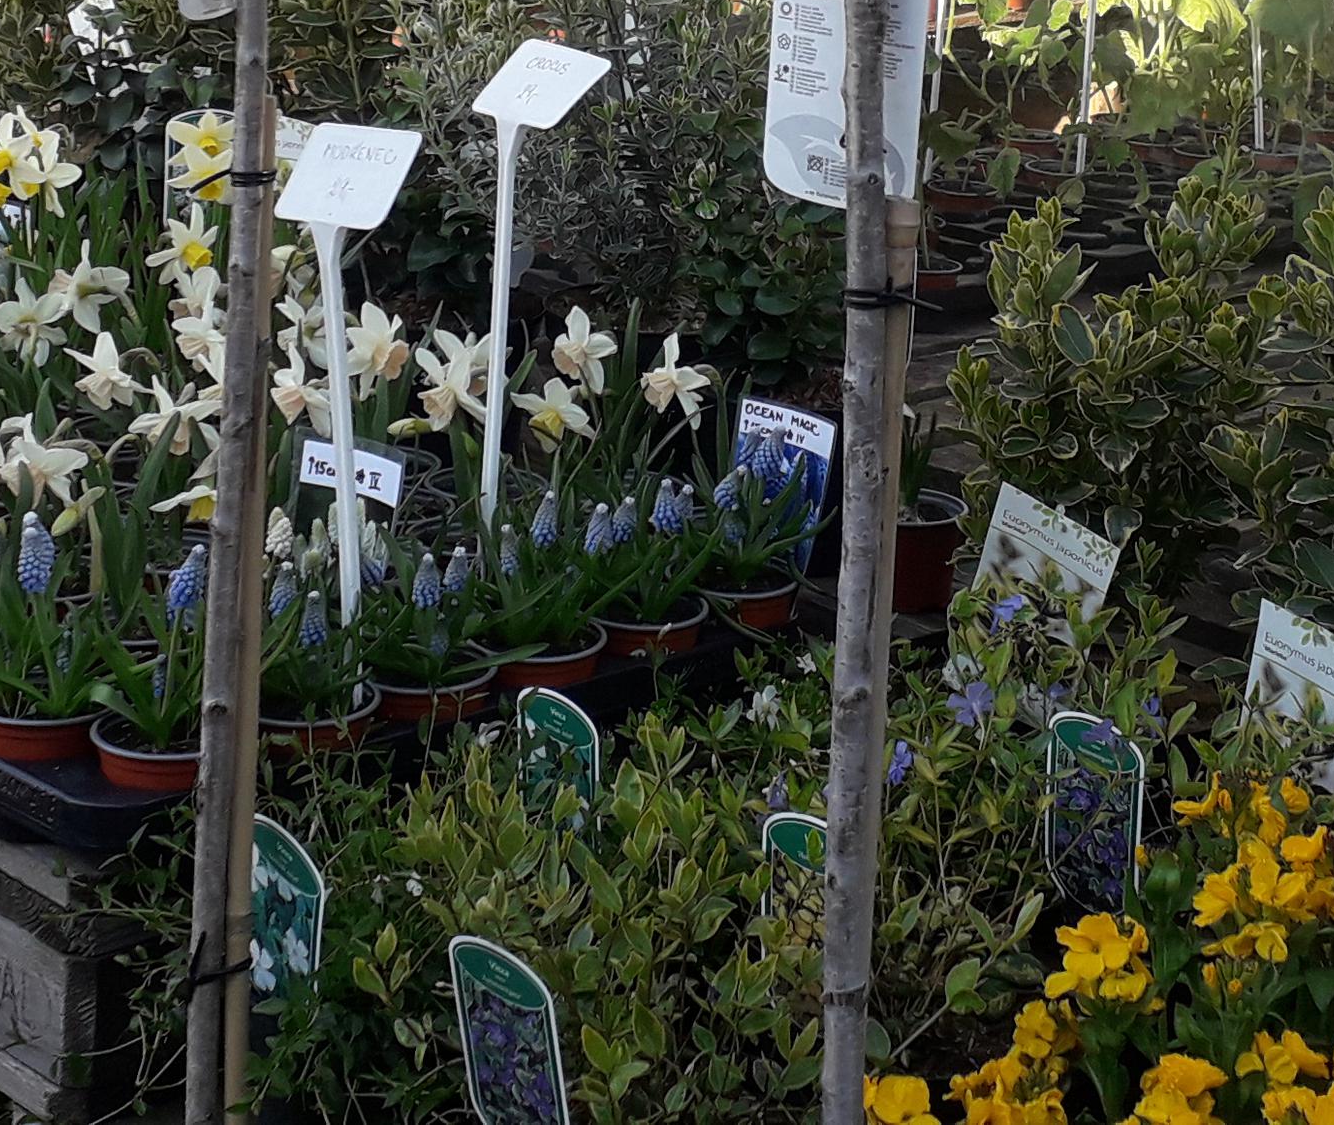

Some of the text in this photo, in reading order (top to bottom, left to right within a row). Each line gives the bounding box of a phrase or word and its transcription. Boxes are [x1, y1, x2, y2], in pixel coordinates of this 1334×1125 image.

[526, 57, 571, 75] CROCUS
[745, 403, 820, 437] OCEAN MAGIC
[1002, 509, 1104, 577] Euonymus japonicus
[1264, 631, 1316, 668] Euonymus
